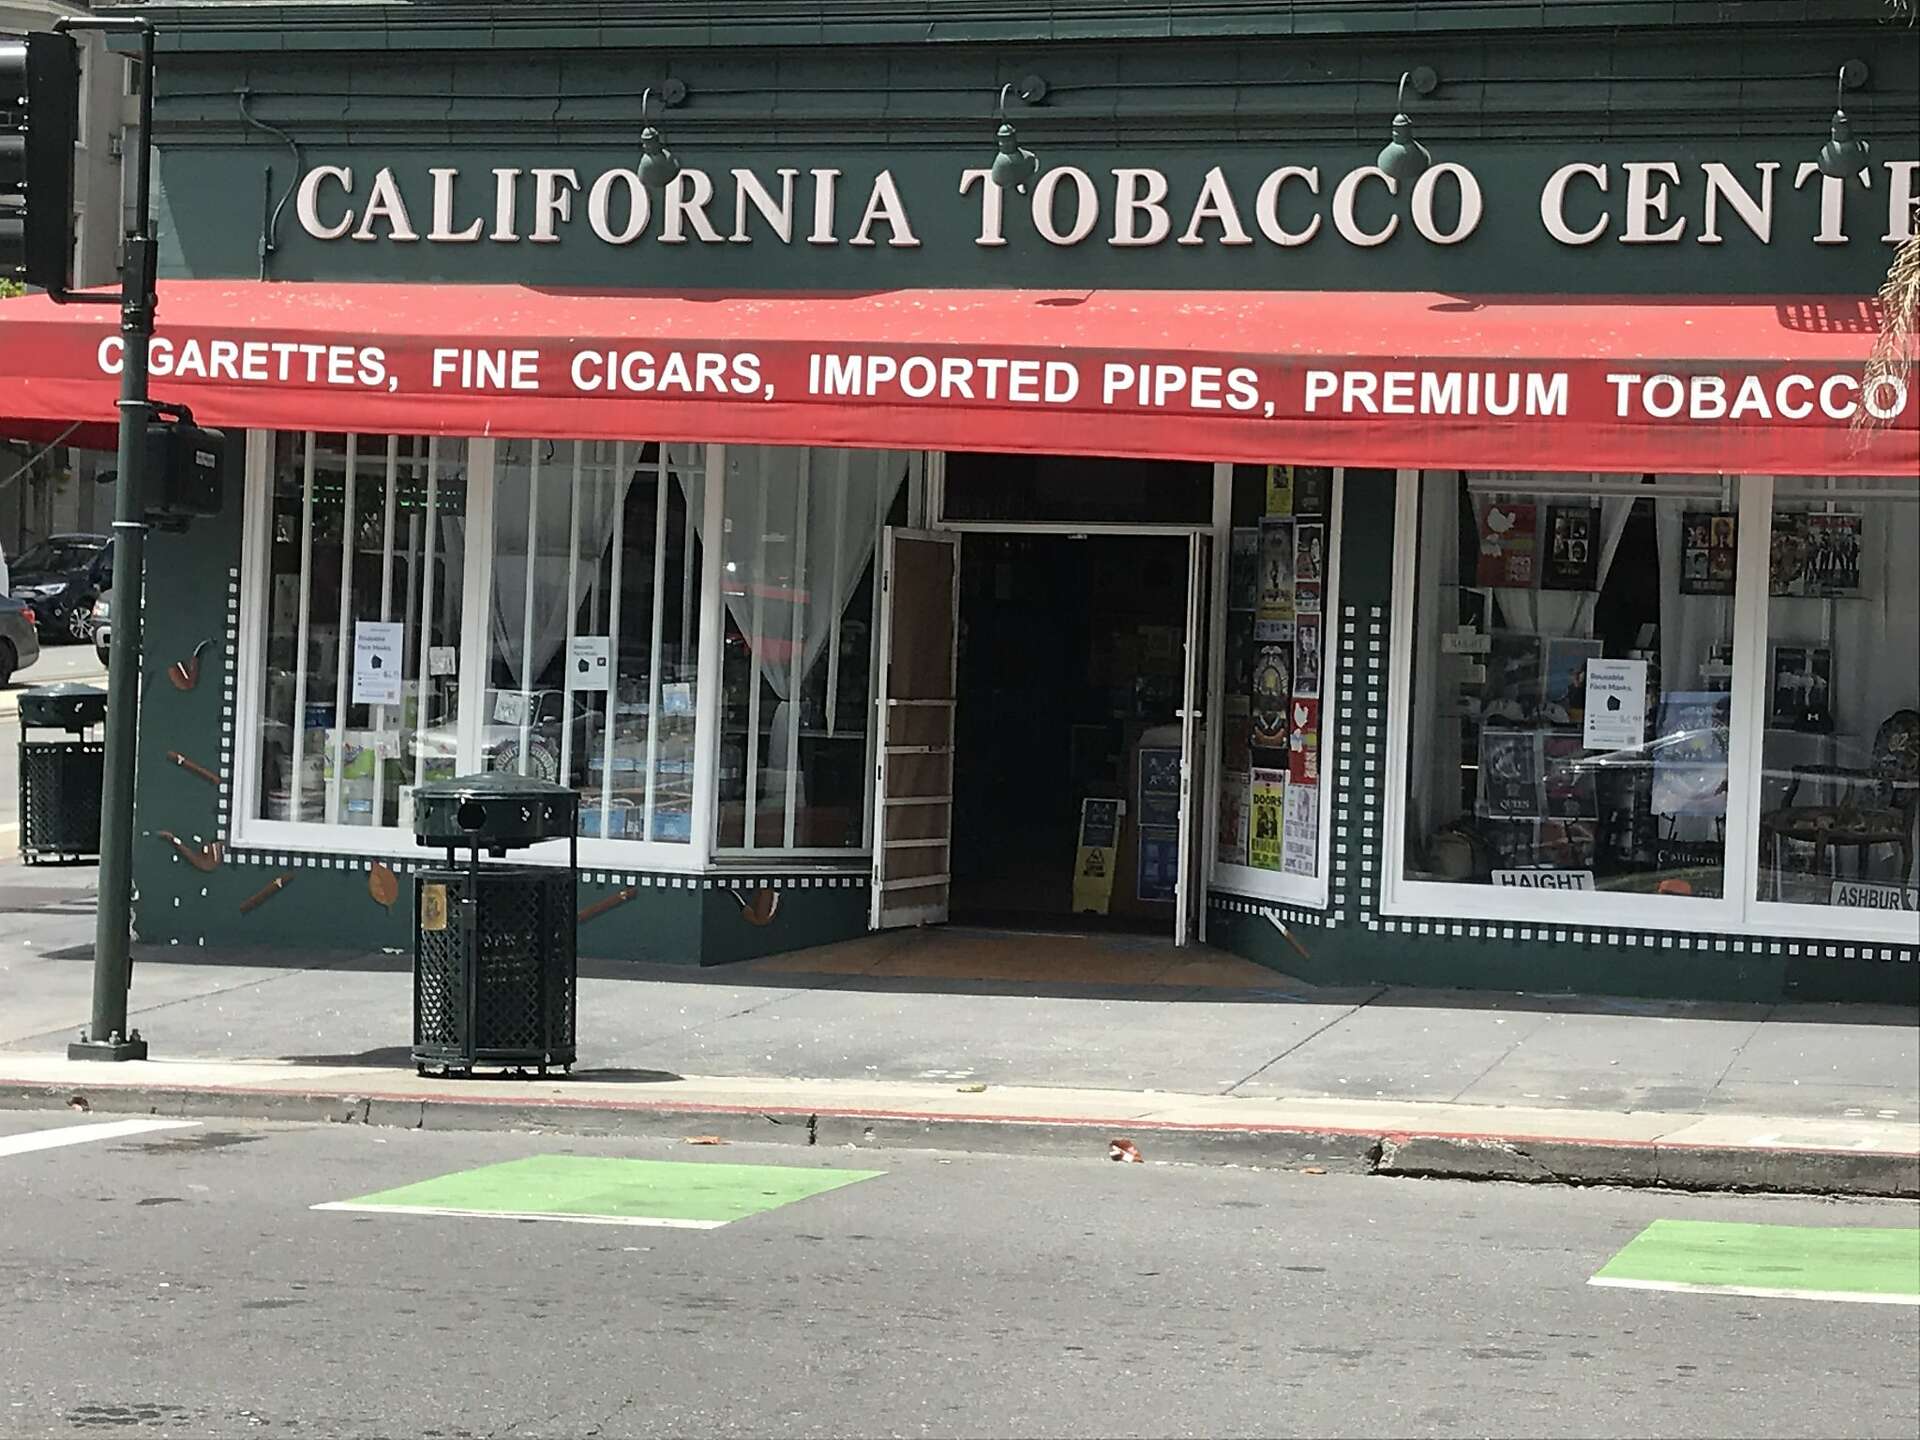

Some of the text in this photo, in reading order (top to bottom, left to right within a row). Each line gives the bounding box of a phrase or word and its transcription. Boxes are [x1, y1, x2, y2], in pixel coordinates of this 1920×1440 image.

[297, 166, 920, 246] CALIFORNIA
[959, 163, 1482, 246] TOBACCO
[98, 336, 1908, 420] CGARETTES, FINE CIGARS, IMPORTED PIPES, PREMIUM TOBACCO
[1253, 794, 1282, 807] DOORS
[1501, 873, 1586, 890] HAIGHT
